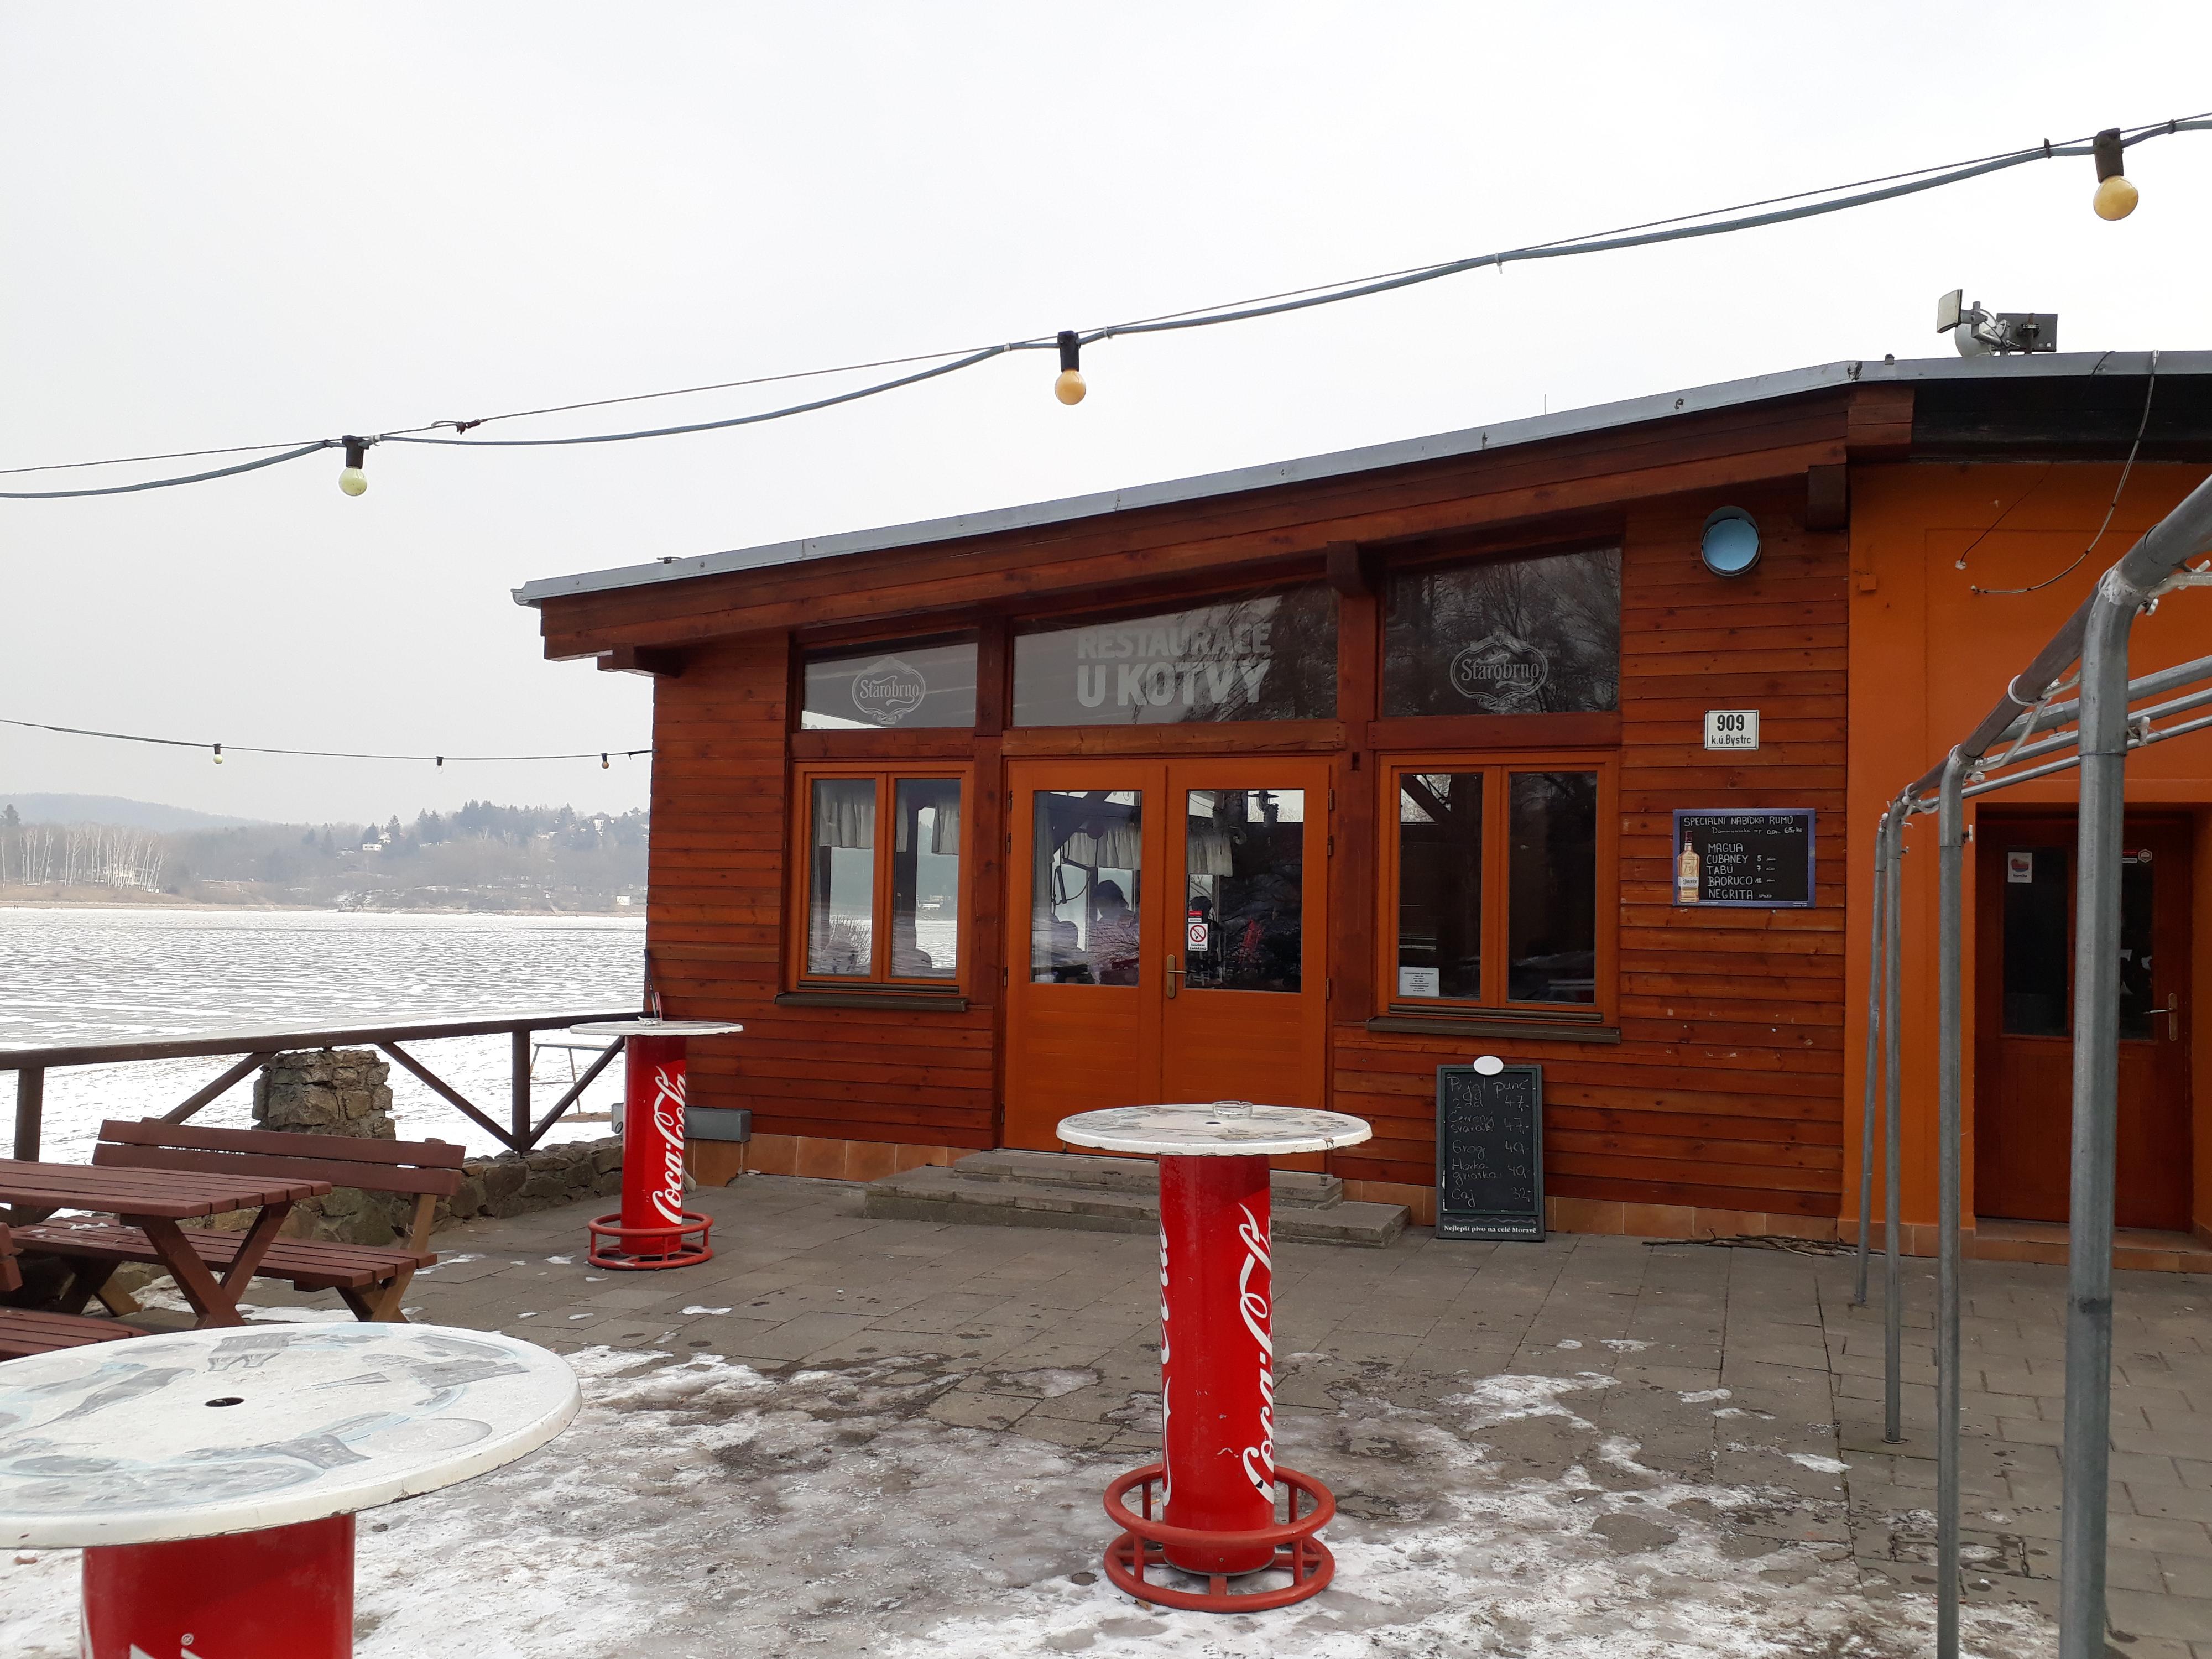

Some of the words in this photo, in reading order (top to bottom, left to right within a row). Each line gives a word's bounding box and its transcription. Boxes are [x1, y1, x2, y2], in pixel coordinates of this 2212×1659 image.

[1078, 623, 1271, 659] RESTAURACE
[1460, 653, 1540, 689] Starobrno
[1077, 664, 1106, 707] U
[1117, 659, 1271, 706] KOTVY
[859, 675, 920, 706] Starobrno
[1717, 714, 1745, 731] 909
[1683, 816, 1727, 827] SPECIÁLNÍ
[1730, 816, 1765, 825] NABÍDKA
[1769, 815, 1794, 825] RUMŮ
[1708, 843, 1744, 853] MAGUA
[1706, 854, 1749, 864] CUBANEY
[1706, 864, 1734, 875] TABÚ
[1707, 875, 1754, 887] BAORUCO
[1708, 888, 1754, 900] NEGRITA
[1452, 1140, 1486, 1160] Grog
